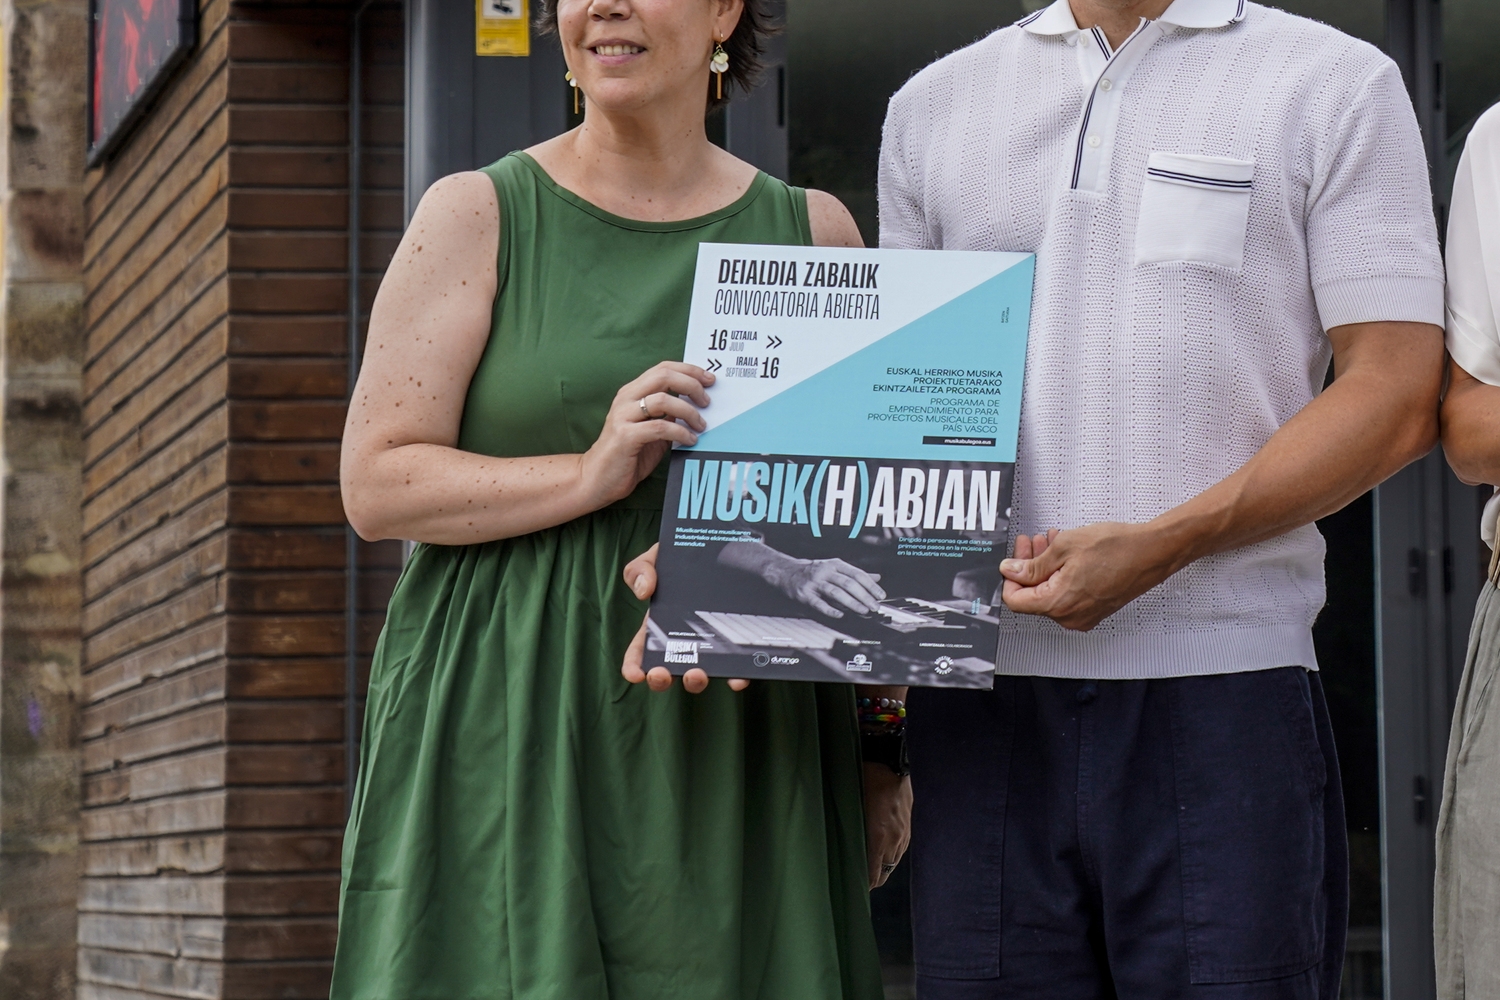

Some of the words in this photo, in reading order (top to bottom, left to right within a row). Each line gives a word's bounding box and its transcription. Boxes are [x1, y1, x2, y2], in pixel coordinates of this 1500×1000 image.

[718, 259, 797, 287] DEIALDIA
[803, 261, 879, 289] ZABALIK
[714, 289, 818, 318] CONVOCATORIA
[823, 293, 880, 320] ABIERTA
[708, 329, 727, 351] 16
[731, 330, 758, 341] UZTAILA
[729, 342, 744, 352] JULIO
[725, 367, 758, 379] SEPTIEMBRE
[736, 356, 758, 367] IRAILA
[761, 357, 779, 379] 16
[887, 367, 921, 376] EUSKAL
[924, 369, 964, 377] HERRIKO
[966, 370, 1003, 378] MUSIKA
[913, 377, 1002, 387] PROIEKTUETARAKO
[873, 384, 944, 394] EKINTZAILETZA
[946, 387, 1001, 395] PROGRAMA
[930, 398, 985, 407] PROGRAMA
[889, 405, 973, 415] EMPRENDIMIENTO
[974, 408, 999, 416] PARA
[867, 413, 923, 423] PROYECTOS
[925, 415, 979, 424] MUSICALES
[980, 417, 998, 425] DEL
[942, 423, 962, 433] PAÍS
[965, 425, 998, 434] VASCO
[677, 459, 1001, 539] MUSIK(H)ABIAN
[666, 641, 698, 654] MUSIKA
[770, 655, 800, 665] durango
